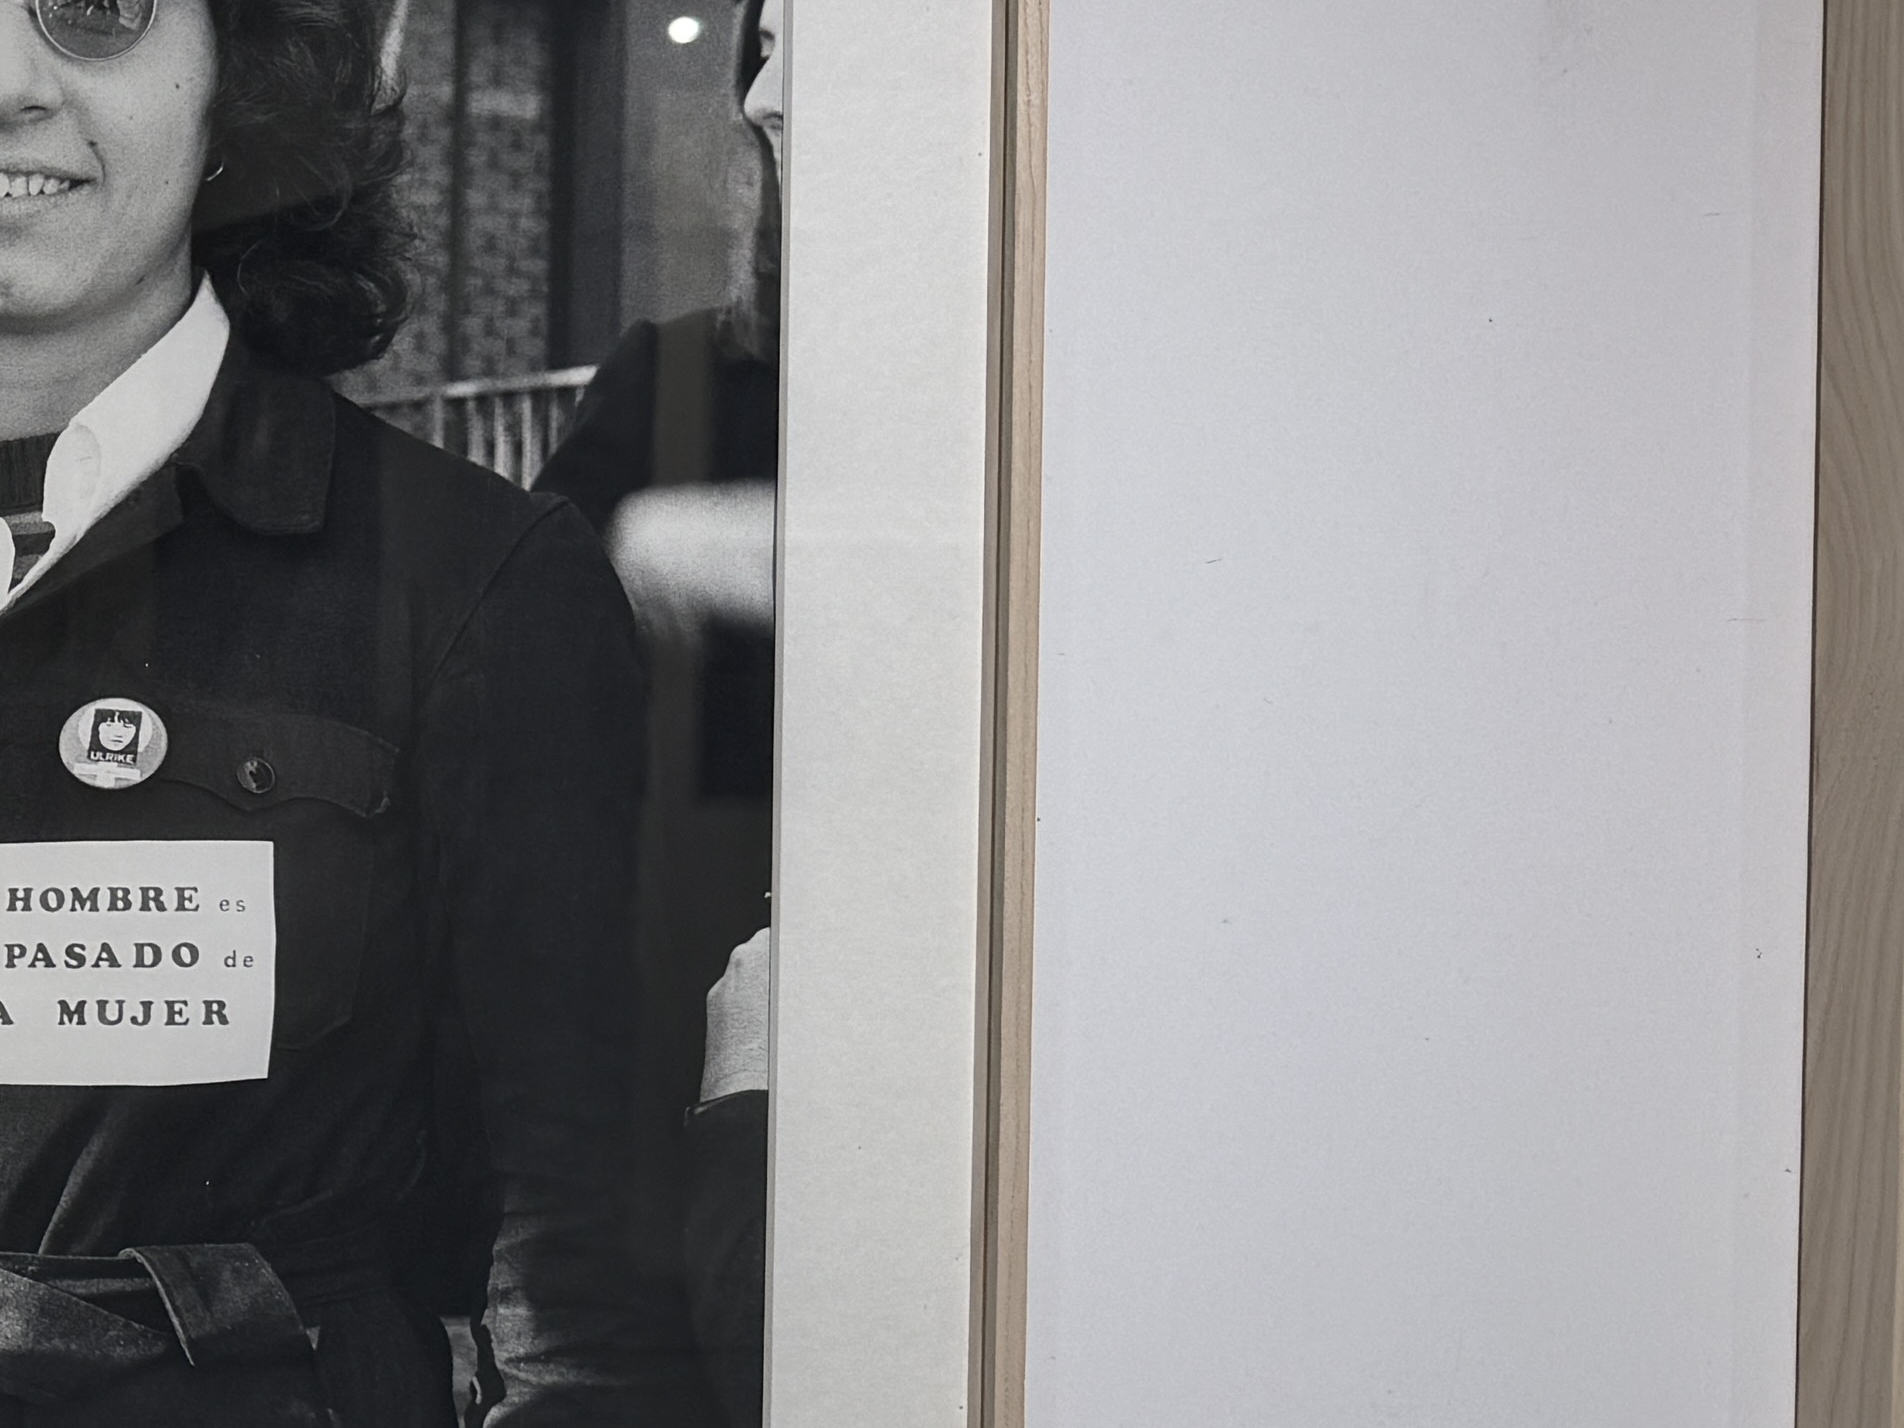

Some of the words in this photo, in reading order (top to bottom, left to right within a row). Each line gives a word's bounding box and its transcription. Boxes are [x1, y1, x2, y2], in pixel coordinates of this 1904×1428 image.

[6, 887, 199, 912] HOMBRE
[219, 899, 246, 912] es
[4, 942, 199, 969] PASADO
[224, 950, 253, 968] de
[57, 999, 229, 1026] MUJER
